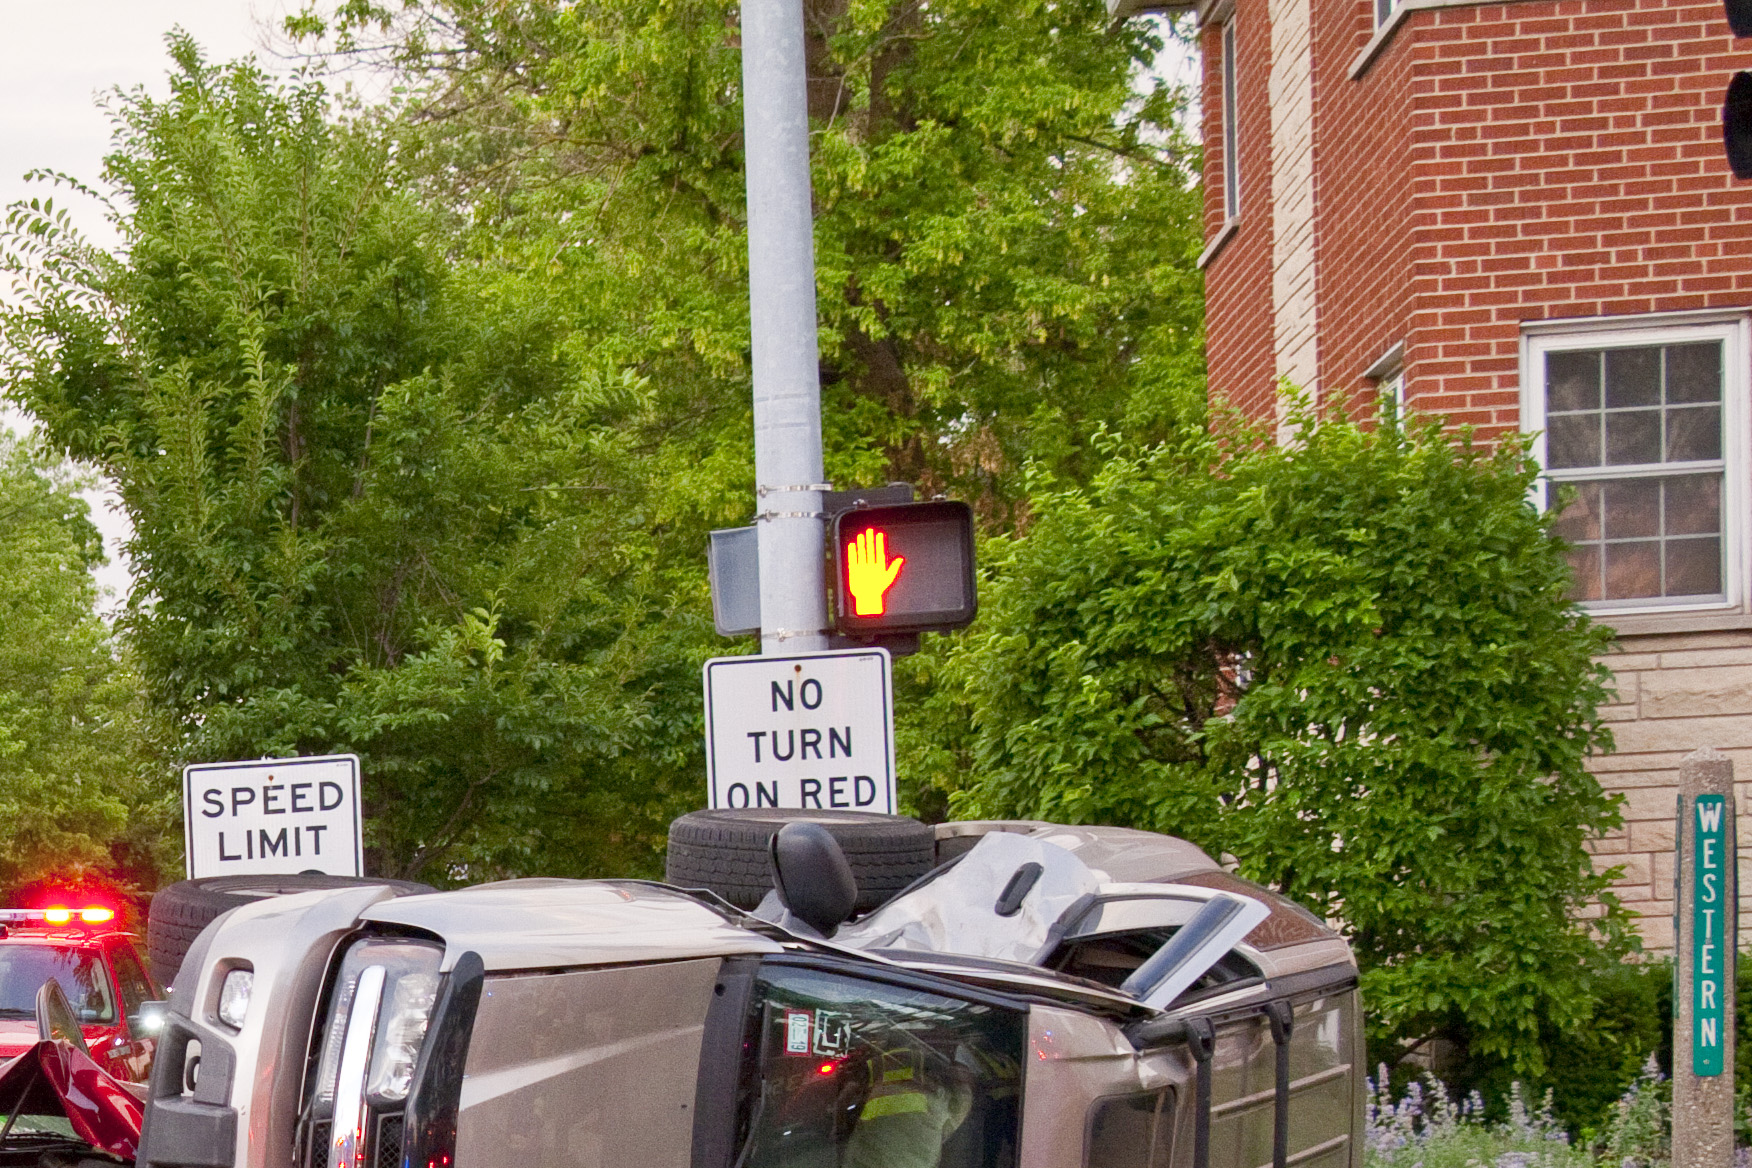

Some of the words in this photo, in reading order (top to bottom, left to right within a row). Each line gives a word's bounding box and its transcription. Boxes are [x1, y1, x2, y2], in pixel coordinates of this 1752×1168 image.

[771, 678, 823, 712] NO
[747, 726, 852, 763] TURN
[202, 781, 344, 818] SPEED
[727, 780, 779, 809] ON
[800, 775, 876, 809] RED
[219, 825, 328, 861] LIMIT
[1697, 802, 1722, 1047] WESTERN
